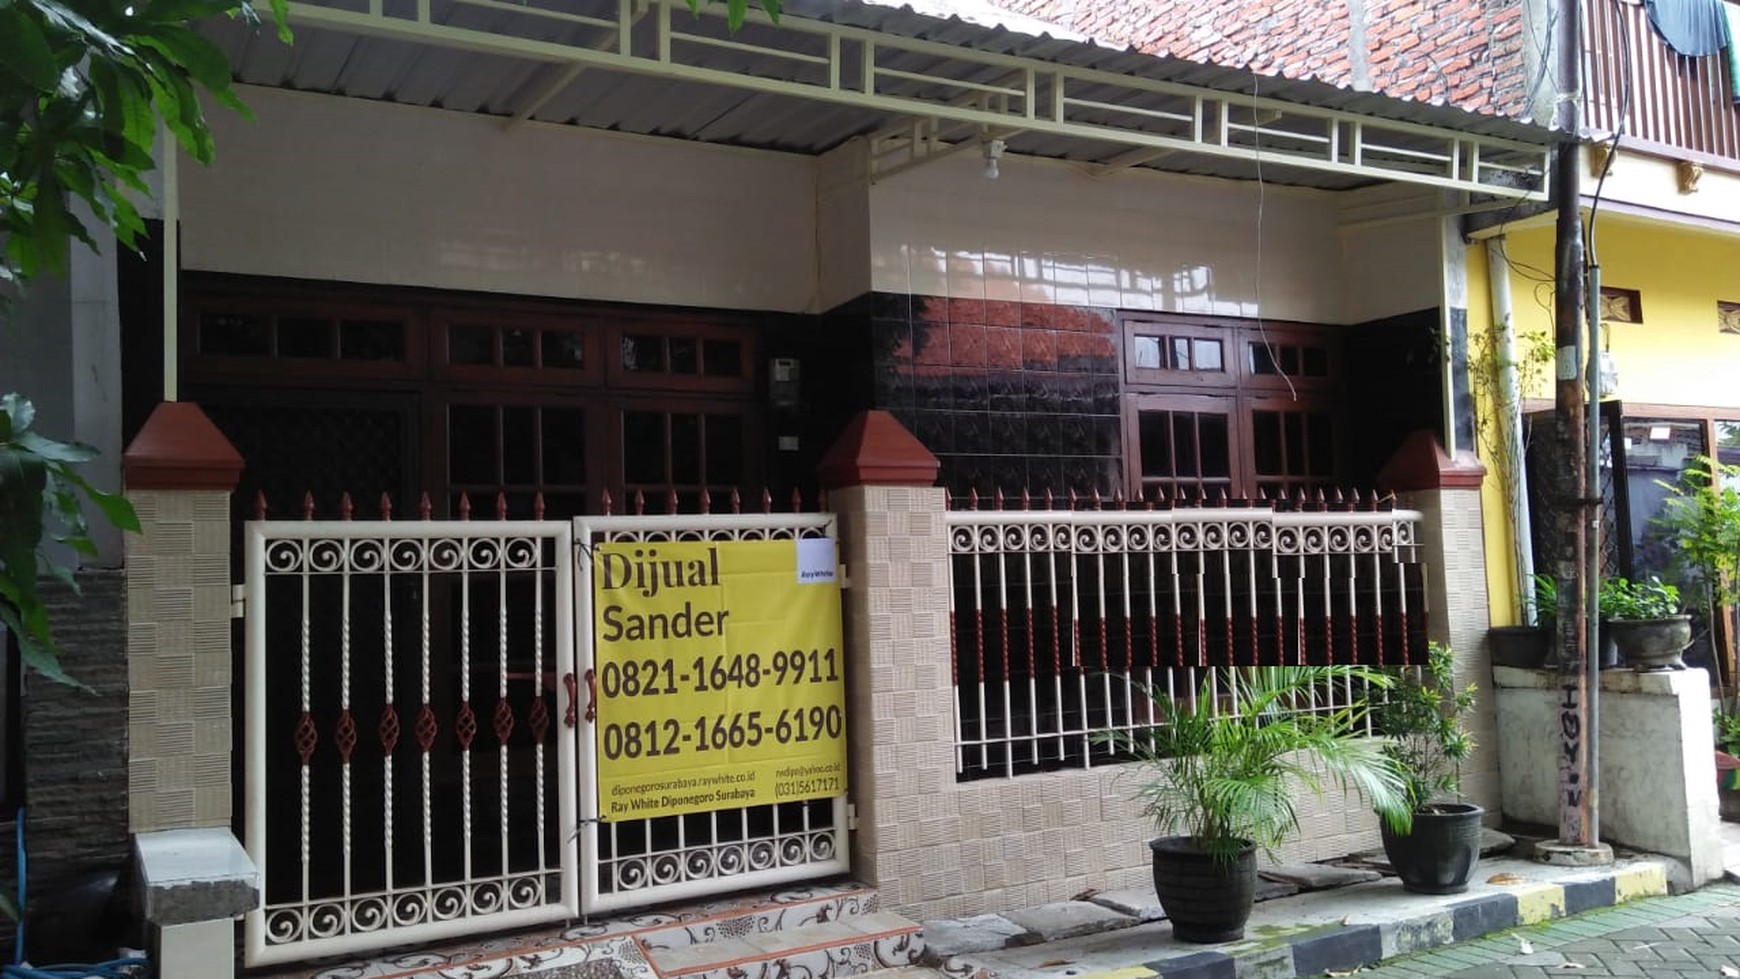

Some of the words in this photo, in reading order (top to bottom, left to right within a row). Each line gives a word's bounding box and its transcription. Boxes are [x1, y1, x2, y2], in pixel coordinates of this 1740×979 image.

[601, 547, 720, 598] Dijual
[602, 601, 729, 642] Sander
[602, 648, 839, 698] 0821-1648-9911
[604, 704, 842, 760] 0812-1665-6190
[611, 801, 628, 813] Ray
[630, 796, 660, 811] White
[661, 792, 715, 808] Diponegoro
[715, 787, 756, 801] Surabaya
[774, 777, 839, 799] (031)5617171
